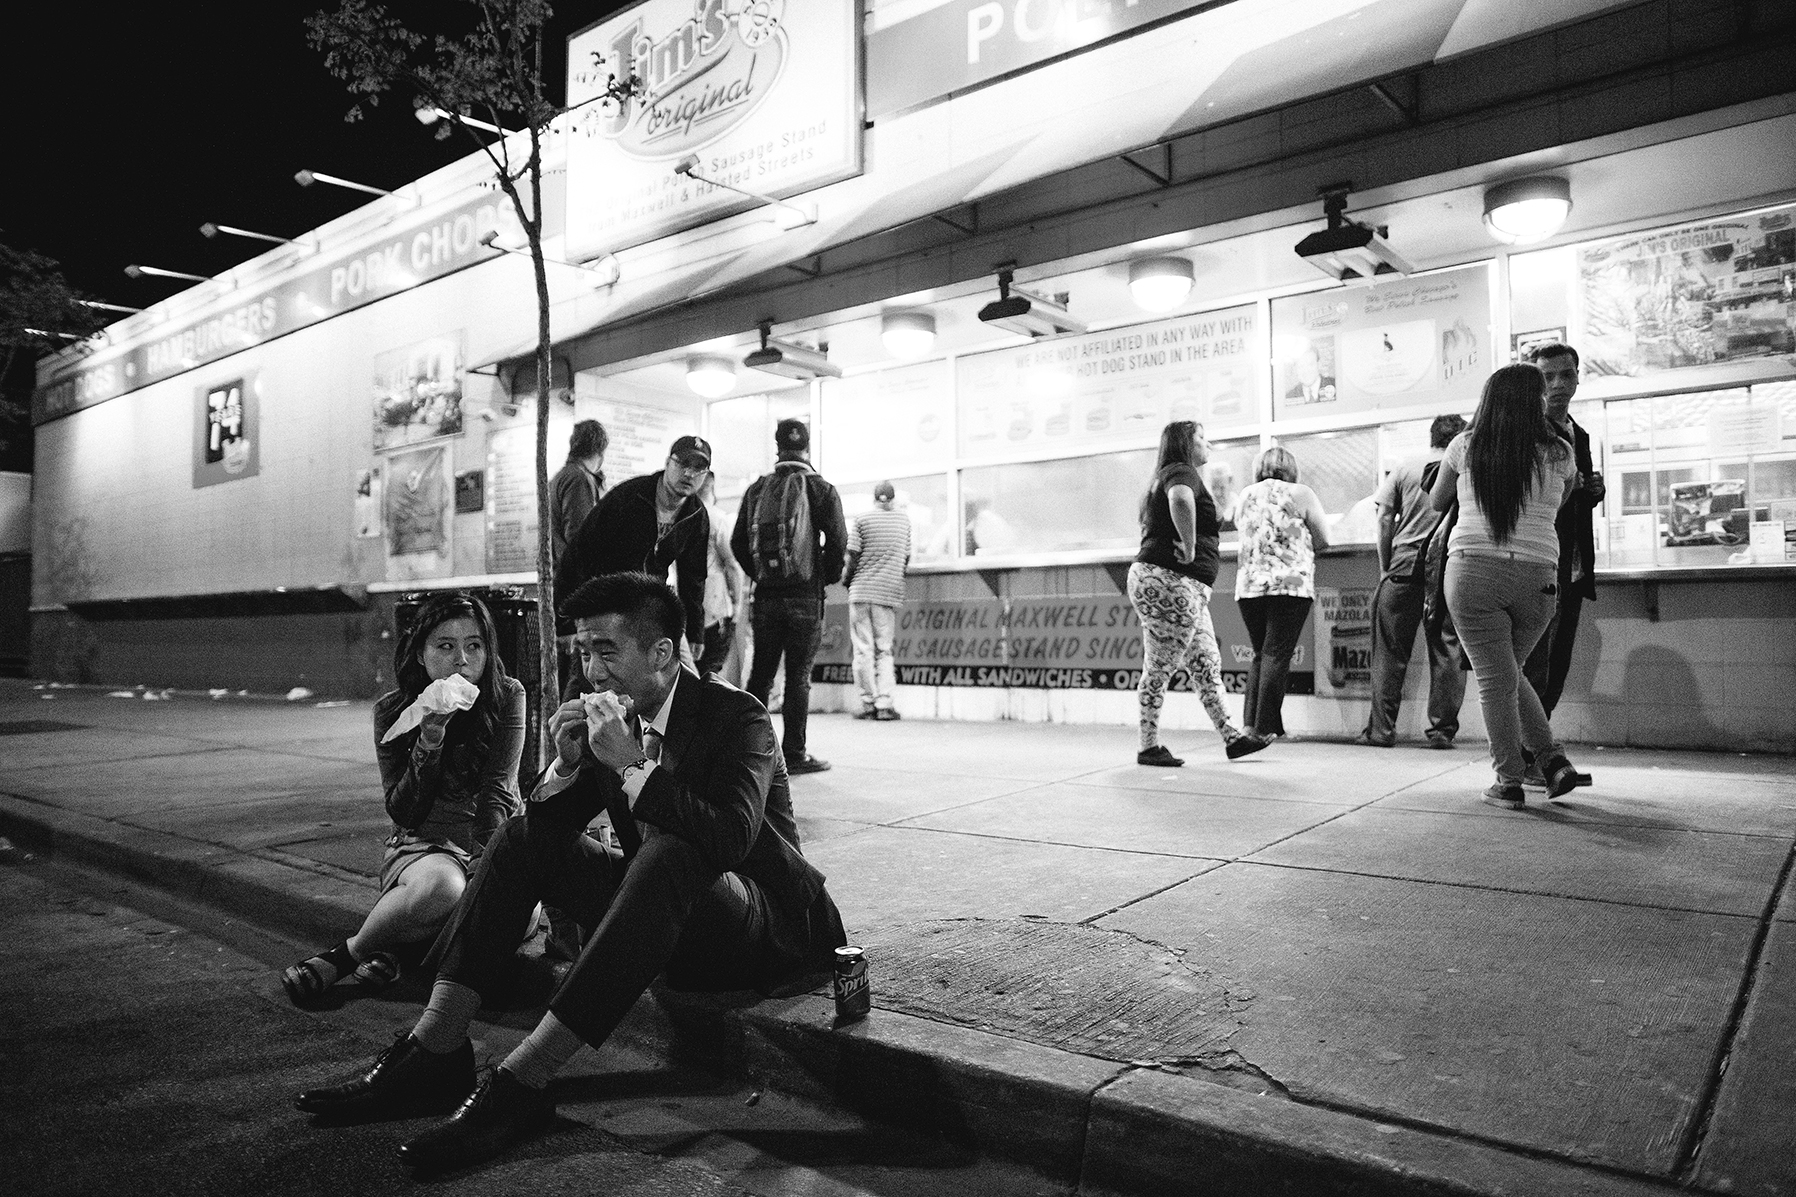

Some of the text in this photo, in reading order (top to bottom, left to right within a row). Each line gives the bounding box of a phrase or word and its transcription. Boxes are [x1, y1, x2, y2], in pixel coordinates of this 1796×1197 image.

[968, 0, 1138, 64] POL
[662, 162, 705, 190] Polih
[711, 141, 774, 173] Sausage
[781, 118, 828, 149] Stand
[758, 147, 814, 176] Streets
[1671, 230, 1730, 252] ORIGINAL
[147, 297, 276, 374] HAMBURGERS
[331, 242, 402, 303] PORK
[1057, 345, 1078, 361] NOT
[1081, 333, 1143, 358] AFFILIATED
[1146, 330, 1159, 347] IN
[1161, 326, 1185, 345] ANY
[1189, 321, 1217, 340] WAY
[1220, 316, 1253, 336] WITH
[1077, 361, 1098, 378] HOT
[1101, 357, 1125, 375] DOG
[1129, 350, 1166, 370] STAND
[1170, 346, 1182, 363] IN
[1186, 342, 1208, 361] THE
[1213, 337, 1246, 357] AREA
[1320, 595, 1369, 608] WE ONLY
[901, 607, 989, 630] ORIGINAL
[1324, 609, 1370, 621] MAZOLA
[917, 637, 1000, 659] SAUSAGE
[1008, 637, 1080, 659] STAND
[1085, 637, 1144, 659] SINC
[1231, 645, 1256, 663] Vie
[1333, 646, 1371, 669] Maz
[901, 666, 942, 684] WITH
[943, 667, 974, 686] ALL
[977, 667, 1092, 688] SANDWICHES
[1113, 670, 1141, 689] OP
[1222, 672, 1247, 692] RS
